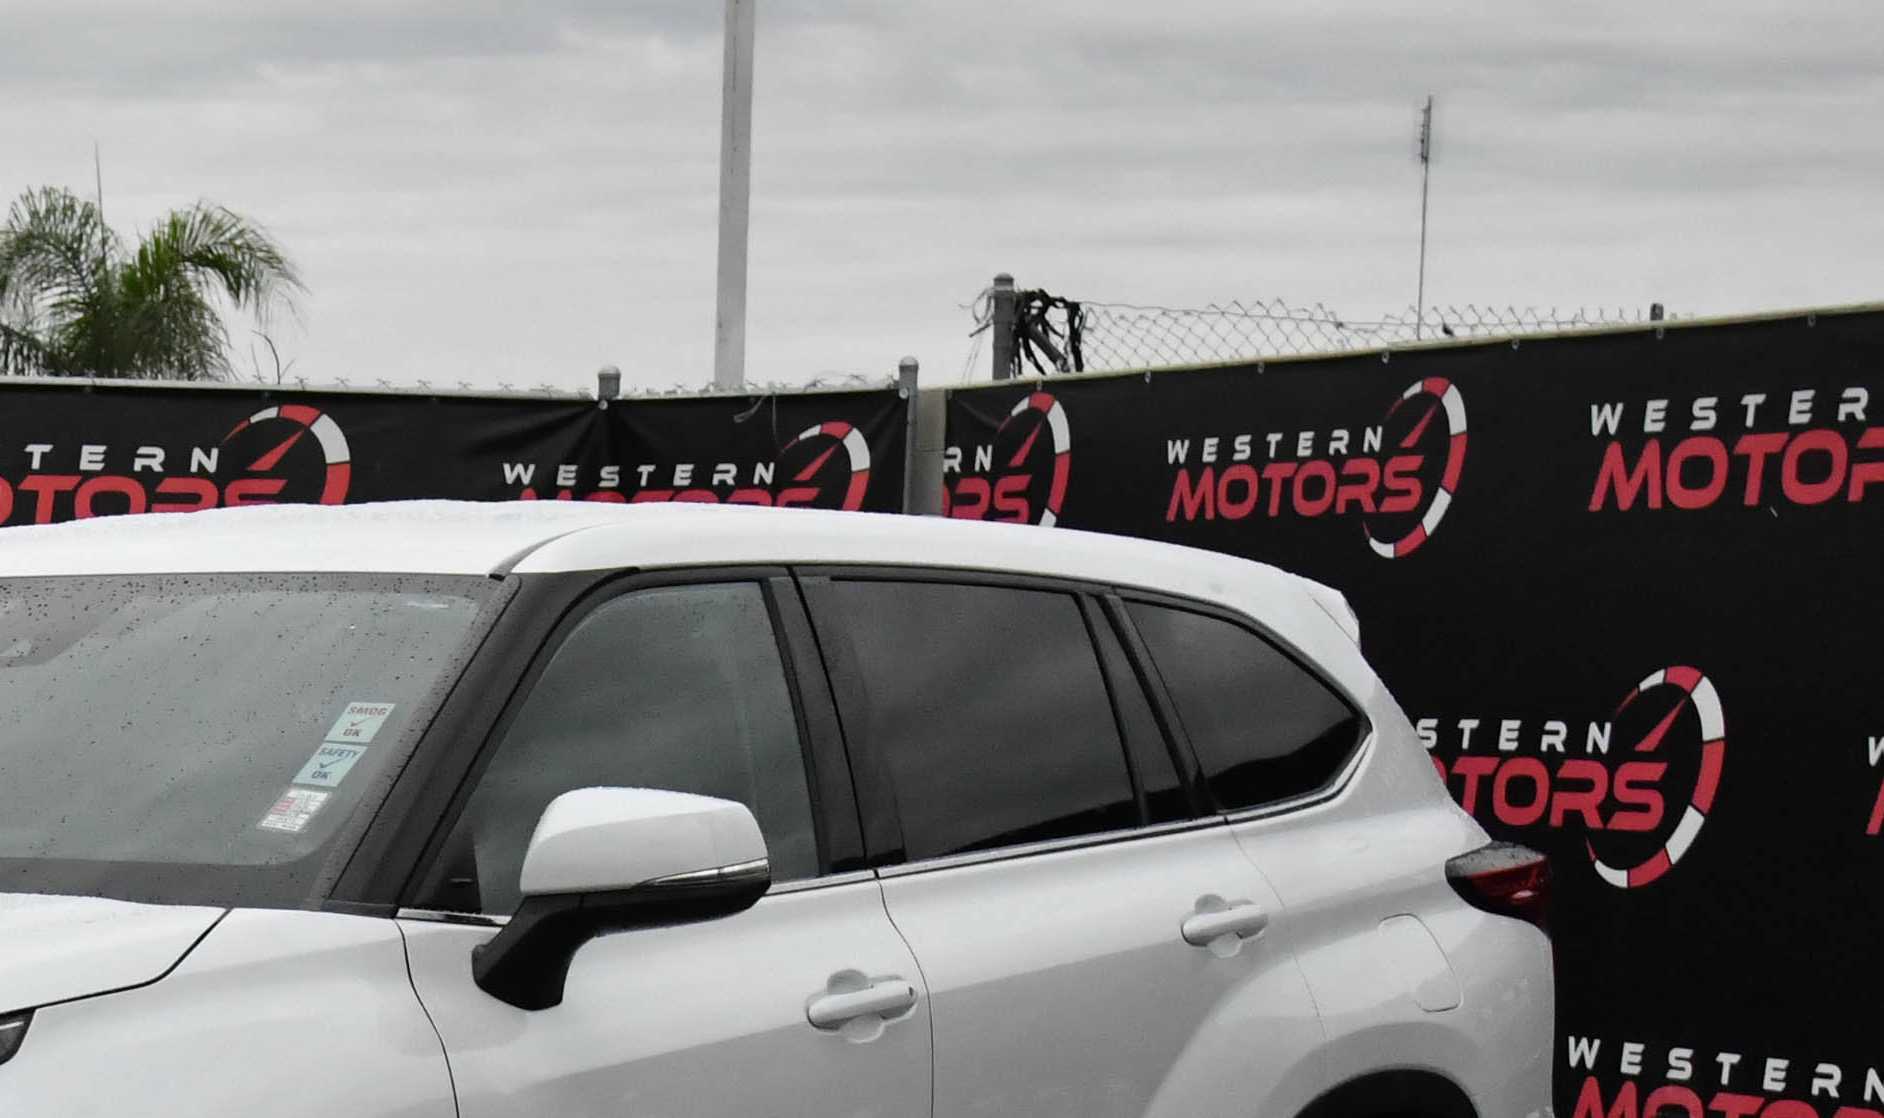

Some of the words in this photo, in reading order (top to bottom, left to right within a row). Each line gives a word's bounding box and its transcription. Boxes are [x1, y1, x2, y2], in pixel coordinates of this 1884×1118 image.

[1591, 387, 1869, 436] WESTER
[1168, 425, 1383, 465] WESTERN
[503, 462, 775, 488] WESTERN
[1166, 455, 1424, 522] MOTORS
[347, 705, 388, 717] SMOG
[343, 728, 362, 738] OK
[1417, 718, 1612, 754] STERN
[319, 747, 358, 758] SAFETY
[311, 770, 330, 780] OK
[1432, 756, 1669, 832] TORS
